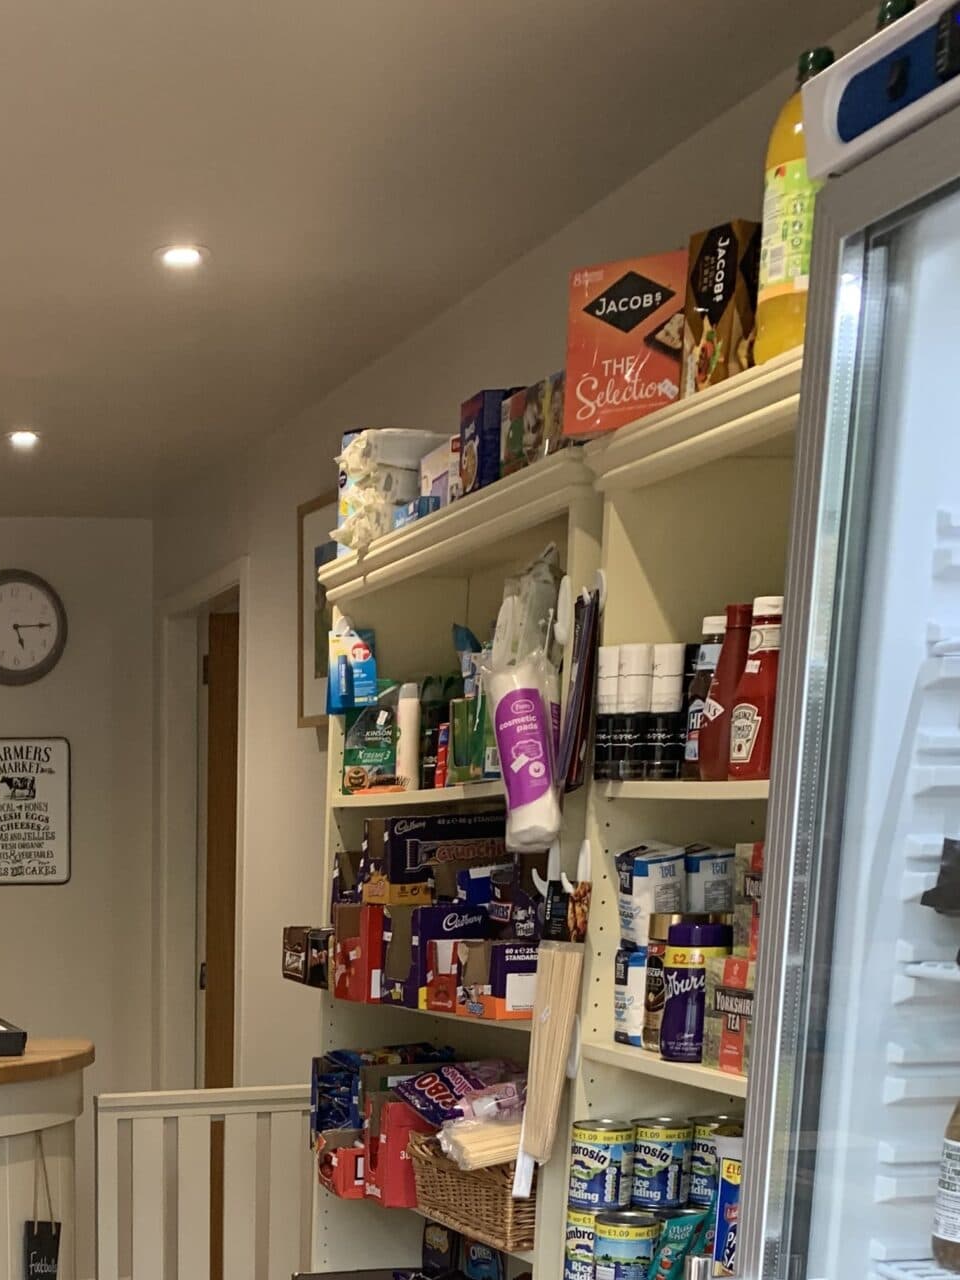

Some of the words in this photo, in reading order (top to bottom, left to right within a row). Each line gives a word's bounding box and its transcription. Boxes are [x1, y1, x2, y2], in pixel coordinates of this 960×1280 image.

[602, 355, 638, 377] THE
[499, 714, 537, 730] cosmetic
[516, 723, 538, 733] pads
[25, 812, 49, 823] EGGS
[0, 822, 41, 832] CHEESES
[22, 832, 56, 841] JELLIES
[25, 866, 56, 876] CAKES
[442, 912, 482, 931] Cadbury
[716, 991, 753, 1016] YORKSHIR
[727, 1013, 740, 1031] TEA
[565, 1268, 592, 1280] Puddi
